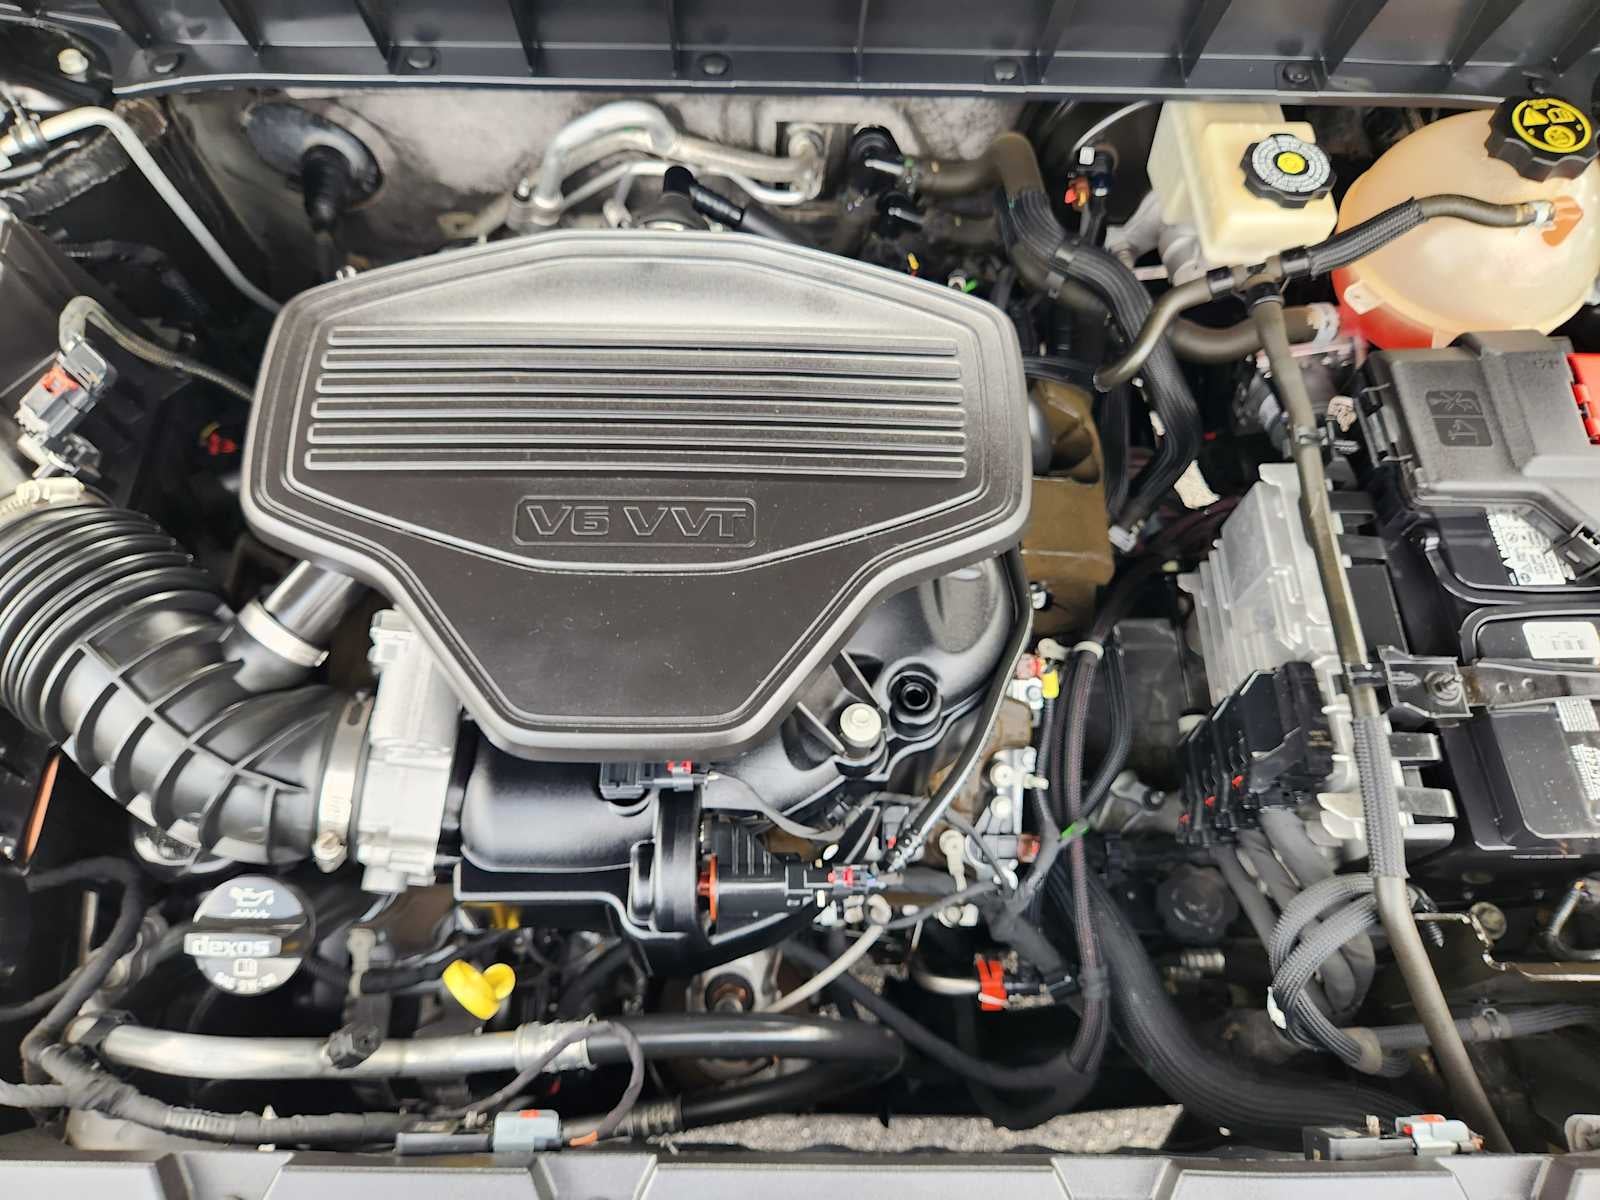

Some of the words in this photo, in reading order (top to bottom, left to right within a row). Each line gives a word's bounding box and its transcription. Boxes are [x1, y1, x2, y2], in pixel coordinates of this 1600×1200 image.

[526, 505, 610, 536] V6
[623, 506, 746, 537] VVT
[191, 934, 271, 956] dexos
